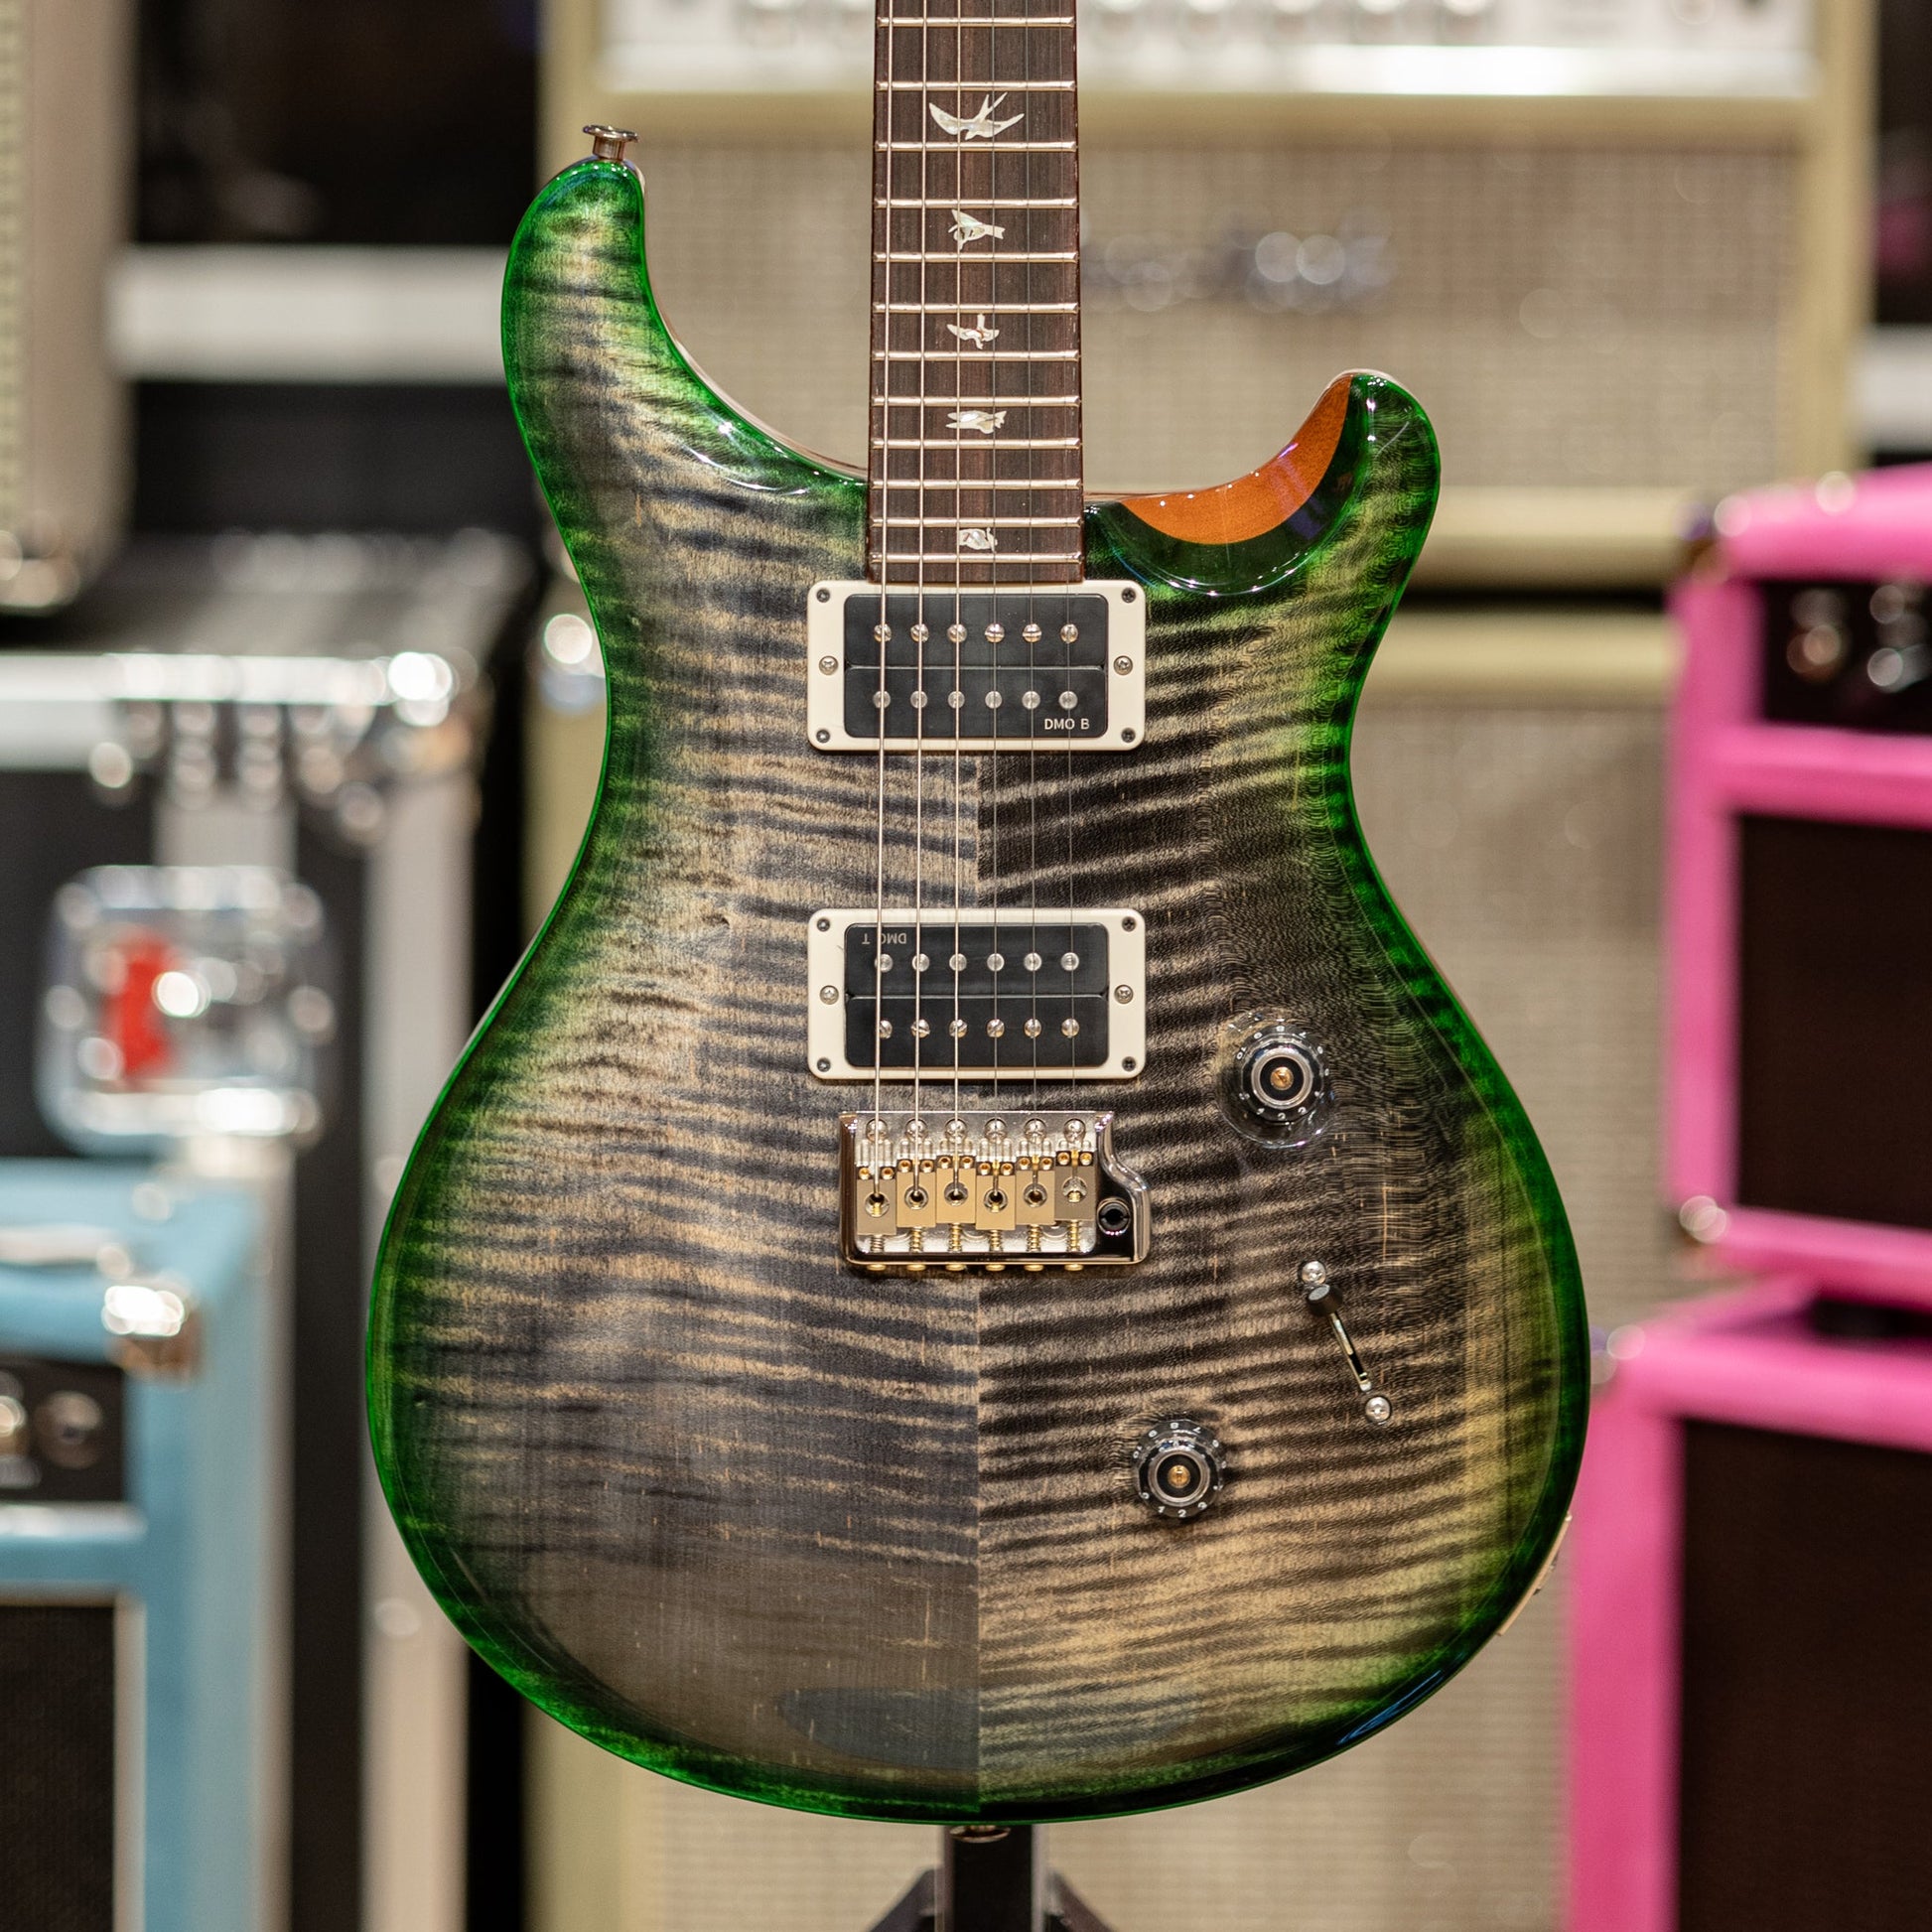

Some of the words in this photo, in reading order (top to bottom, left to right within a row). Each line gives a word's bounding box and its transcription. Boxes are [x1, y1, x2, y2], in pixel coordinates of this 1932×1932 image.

[1044, 718, 1075, 730] DMO
[1080, 718, 1090, 730] B
[862, 933, 871, 945] T
